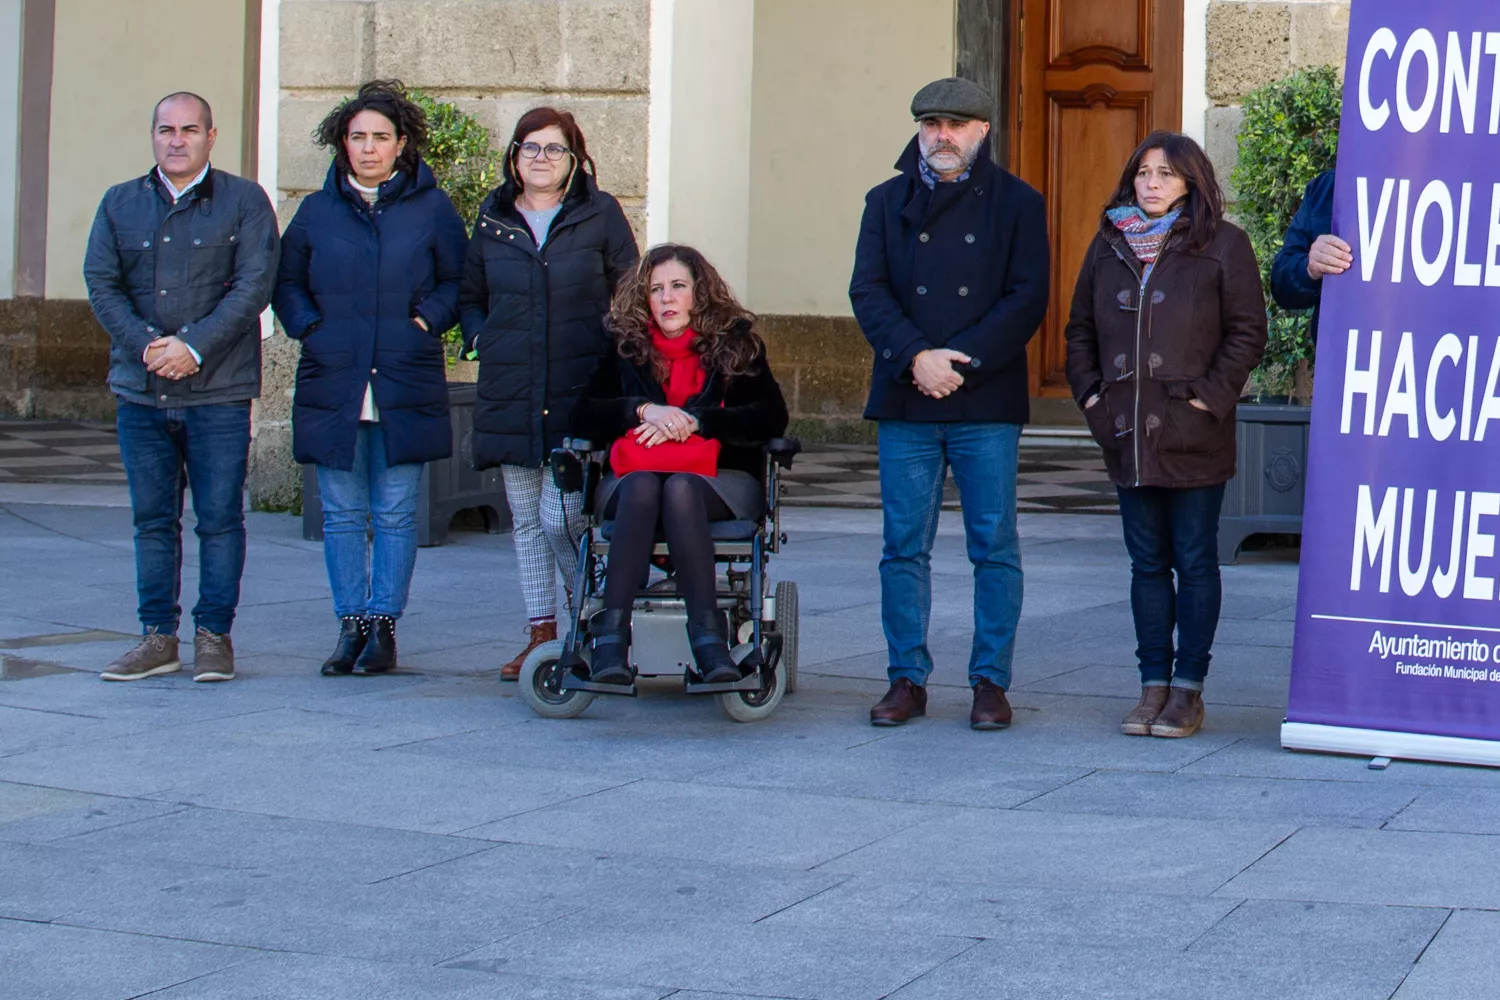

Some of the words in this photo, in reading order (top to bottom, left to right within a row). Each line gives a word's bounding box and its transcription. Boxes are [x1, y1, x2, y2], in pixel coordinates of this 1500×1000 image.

[1368, 630, 1490, 663] Ayuntamiento
[1395, 662, 1442, 677] Fundación
[1443, 666, 1488, 682] Municipal
